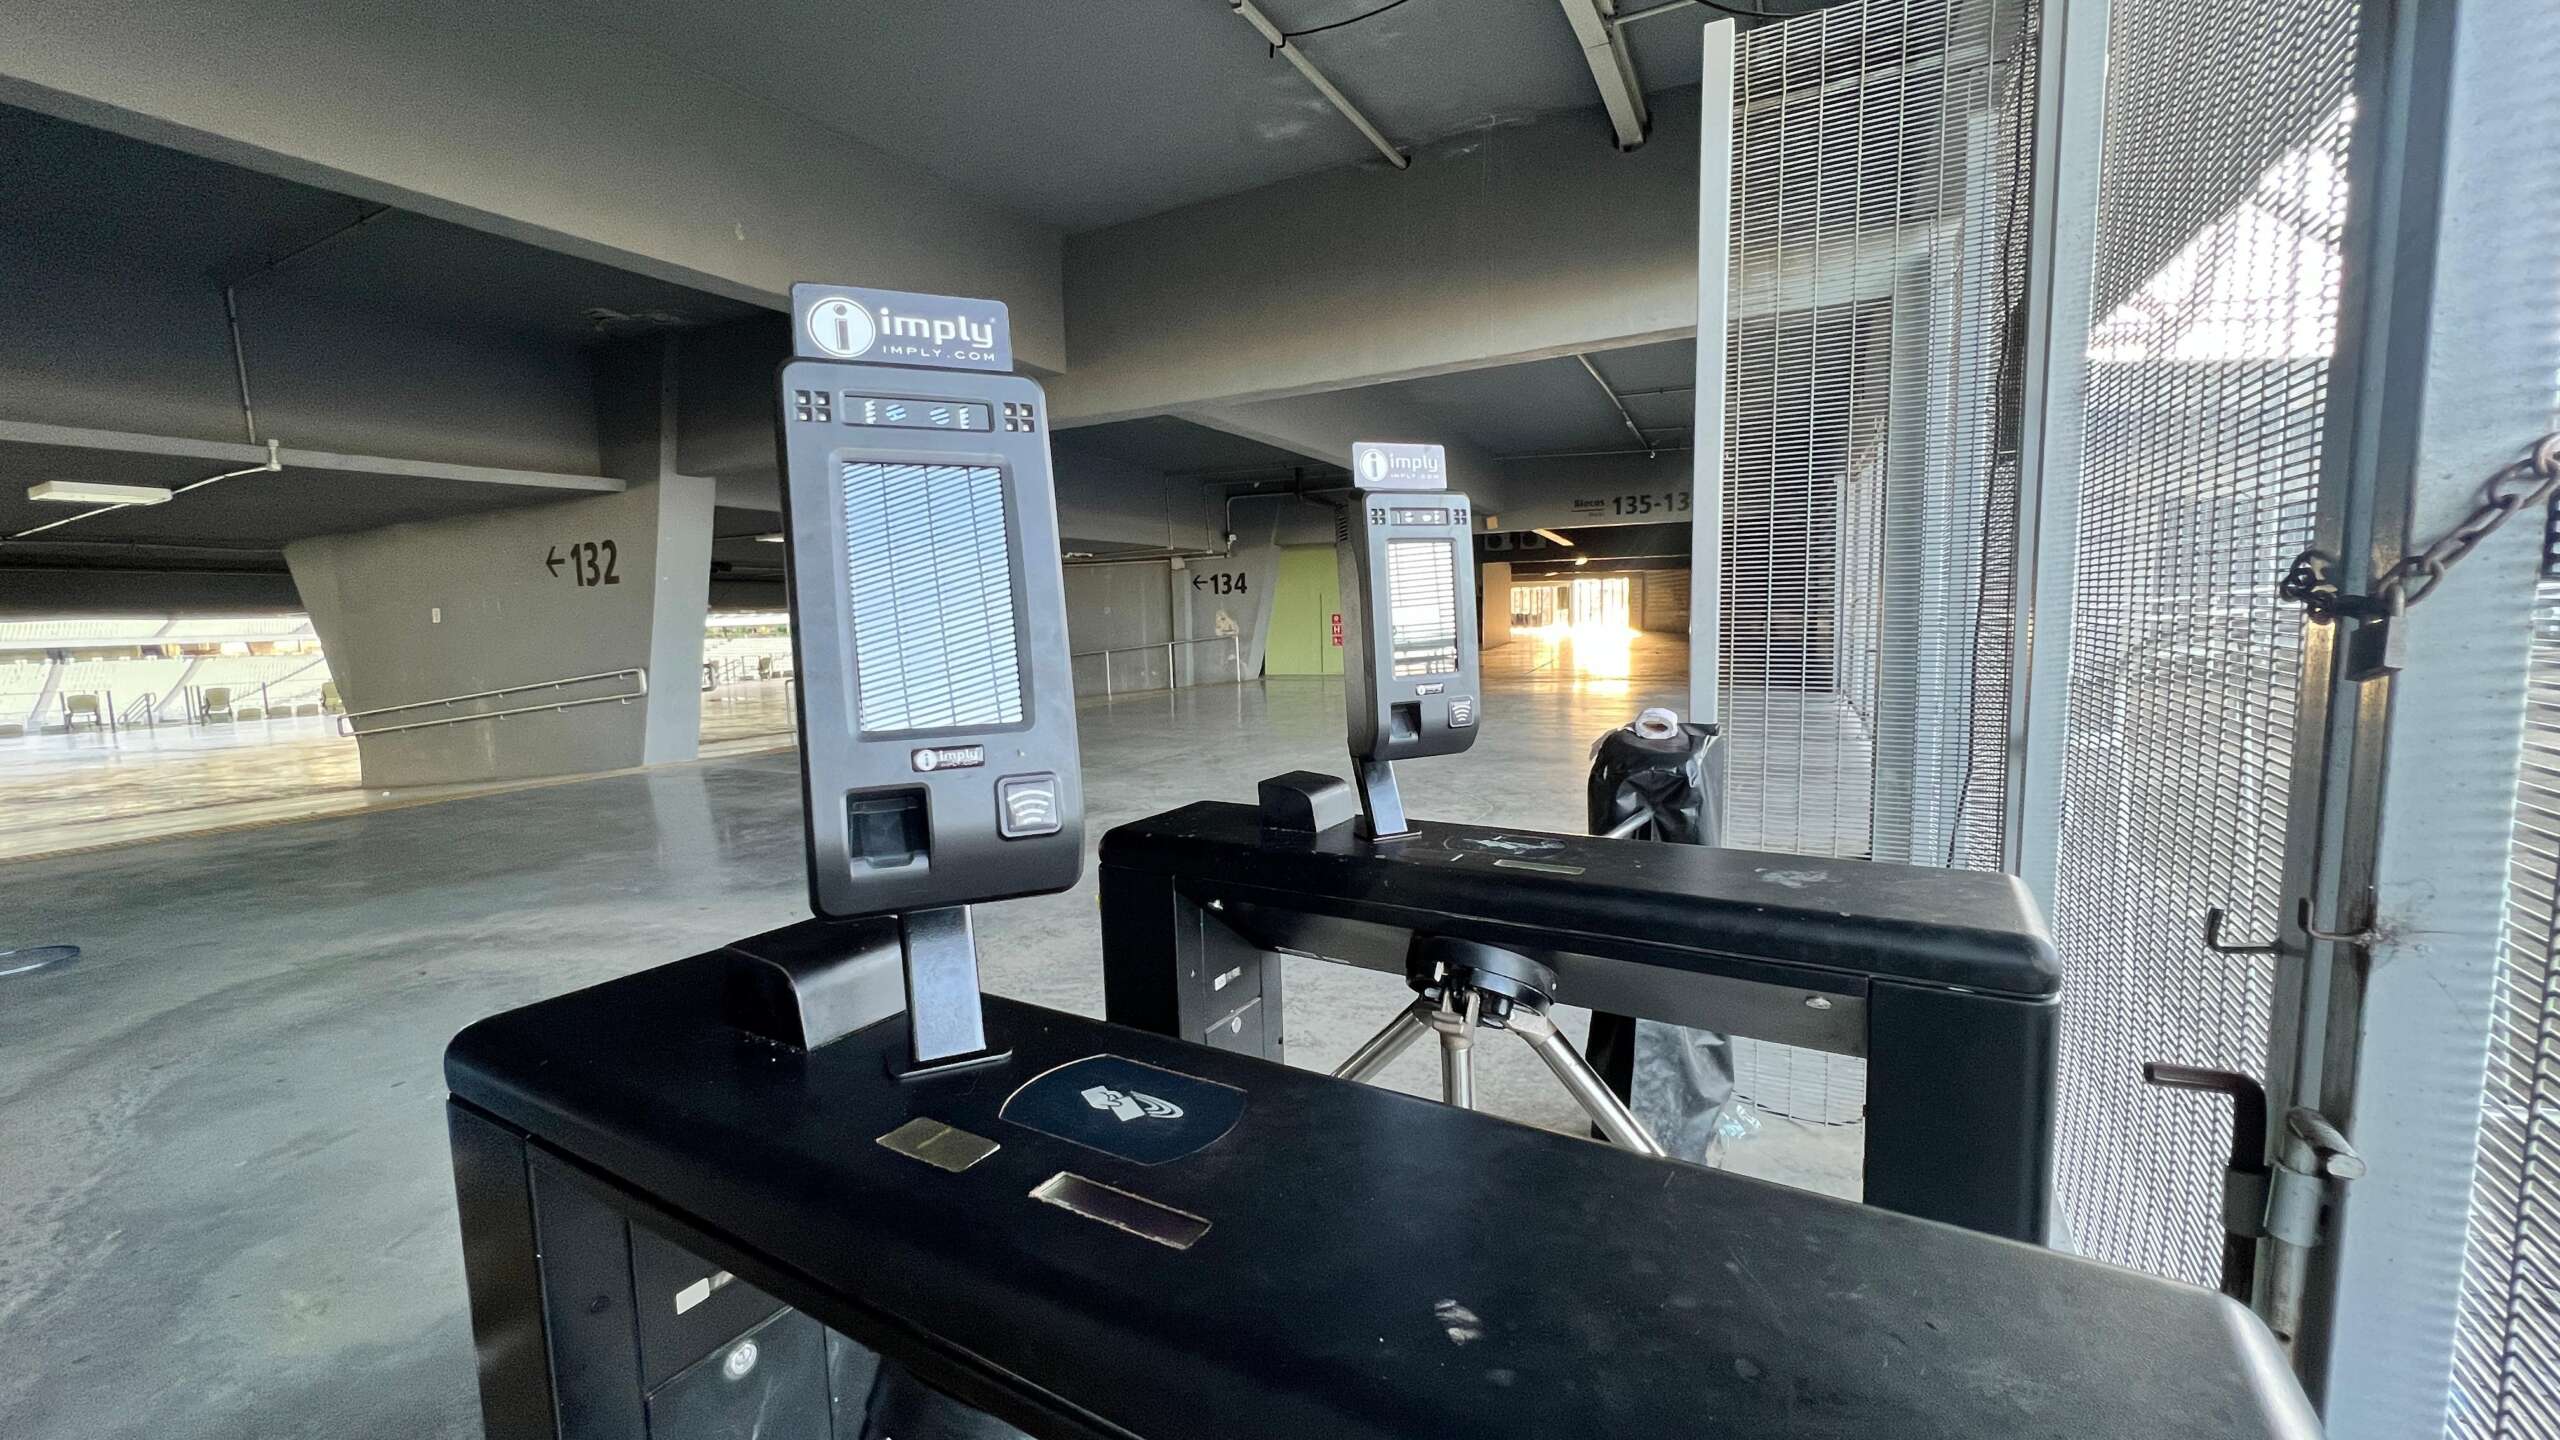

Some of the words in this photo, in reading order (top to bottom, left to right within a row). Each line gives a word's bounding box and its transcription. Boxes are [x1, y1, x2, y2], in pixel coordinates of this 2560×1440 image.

[879, 306, 994, 349] imply
[882, 345, 995, 362] IMPLY.COM
[1389, 453, 1438, 473] imply
[570, 540, 620, 587] 132
[1210, 572, 1247, 594] 134
[939, 748, 978, 763] imply
